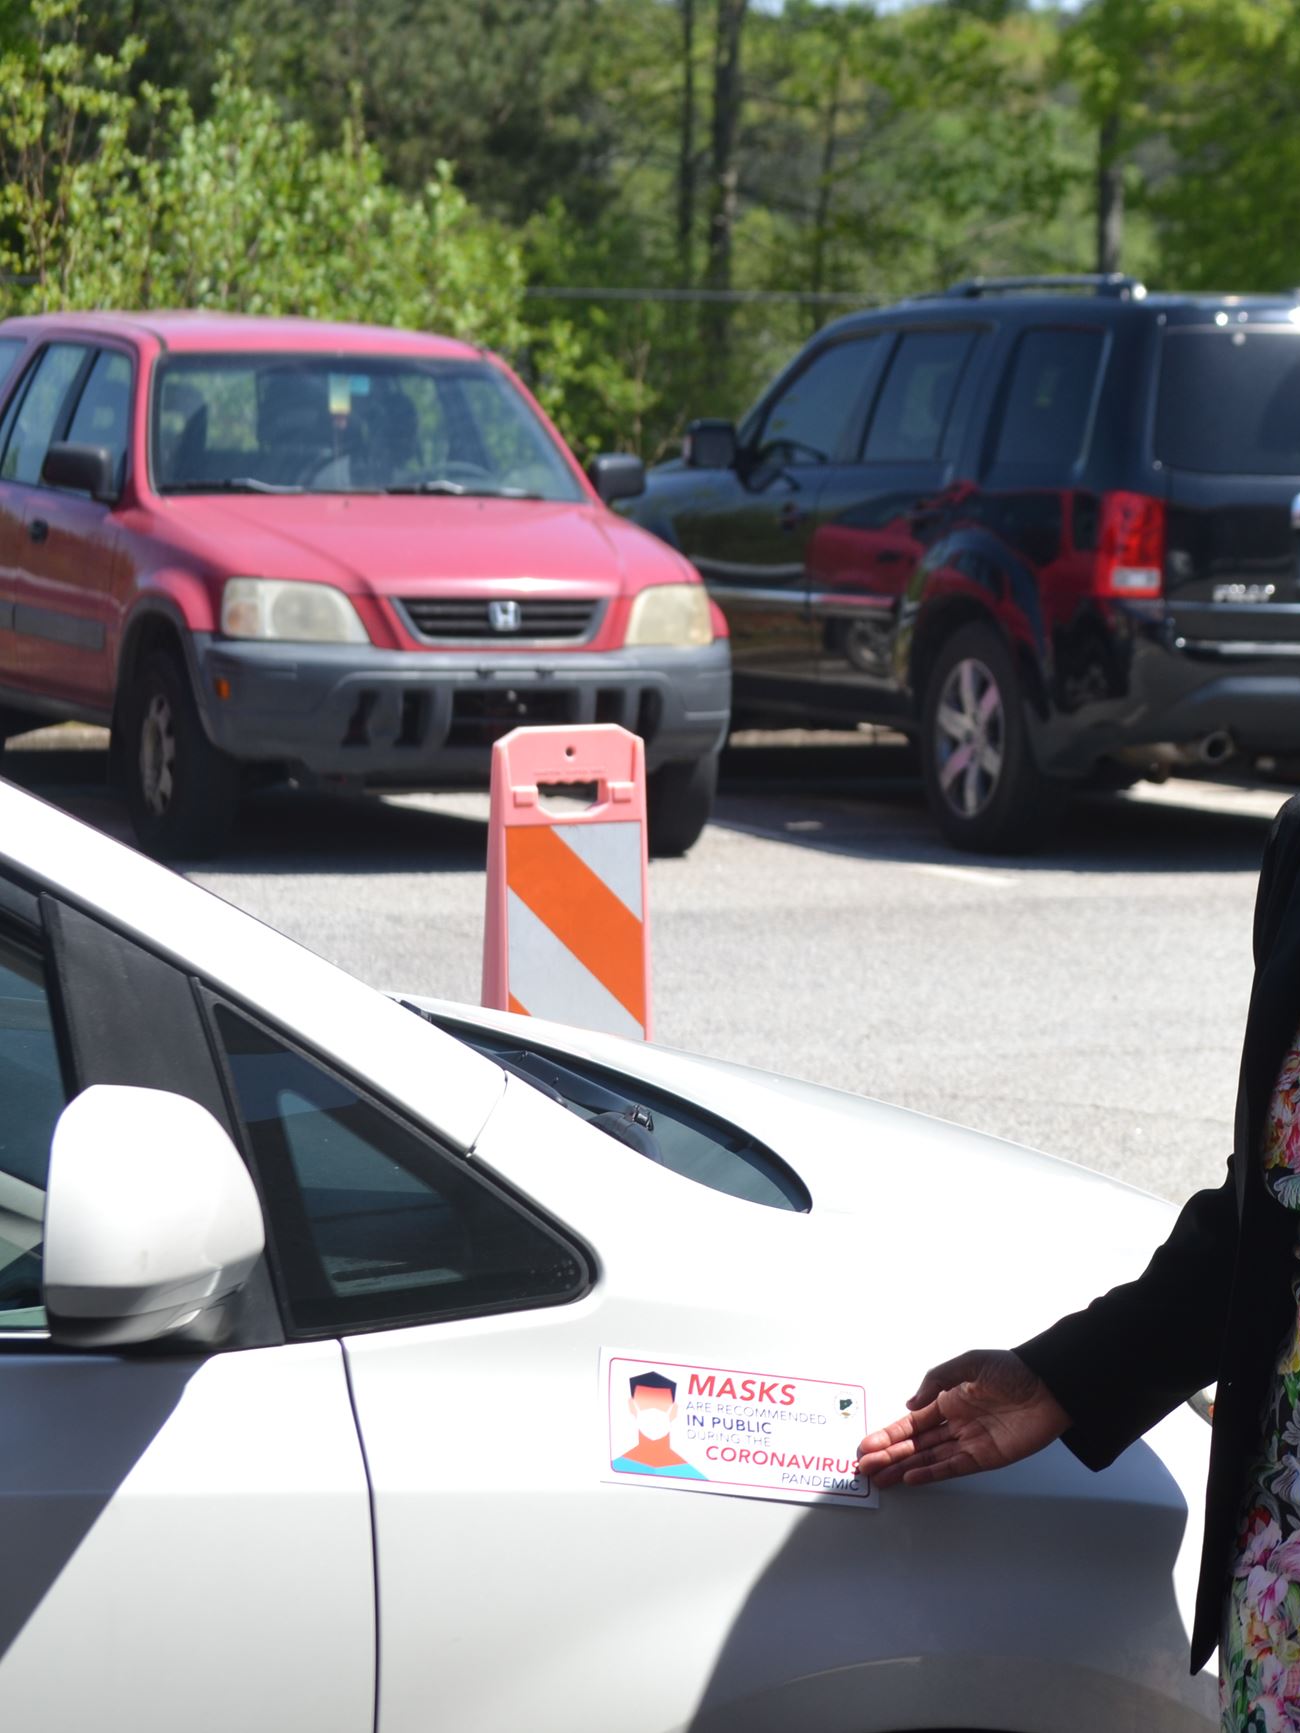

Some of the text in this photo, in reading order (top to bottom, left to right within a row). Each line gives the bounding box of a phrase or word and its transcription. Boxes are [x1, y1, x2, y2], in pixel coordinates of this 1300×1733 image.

[687, 1373, 796, 1406] MASKS
[686, 1400, 827, 1425] ARE RECOMMENDED
[687, 1414, 772, 1435] IN PUBLIC
[687, 1429, 771, 1448] DURING THE
[705, 1445, 861, 1475] CORONAVIRUS
[781, 1473, 860, 1491] PANDEMIC
